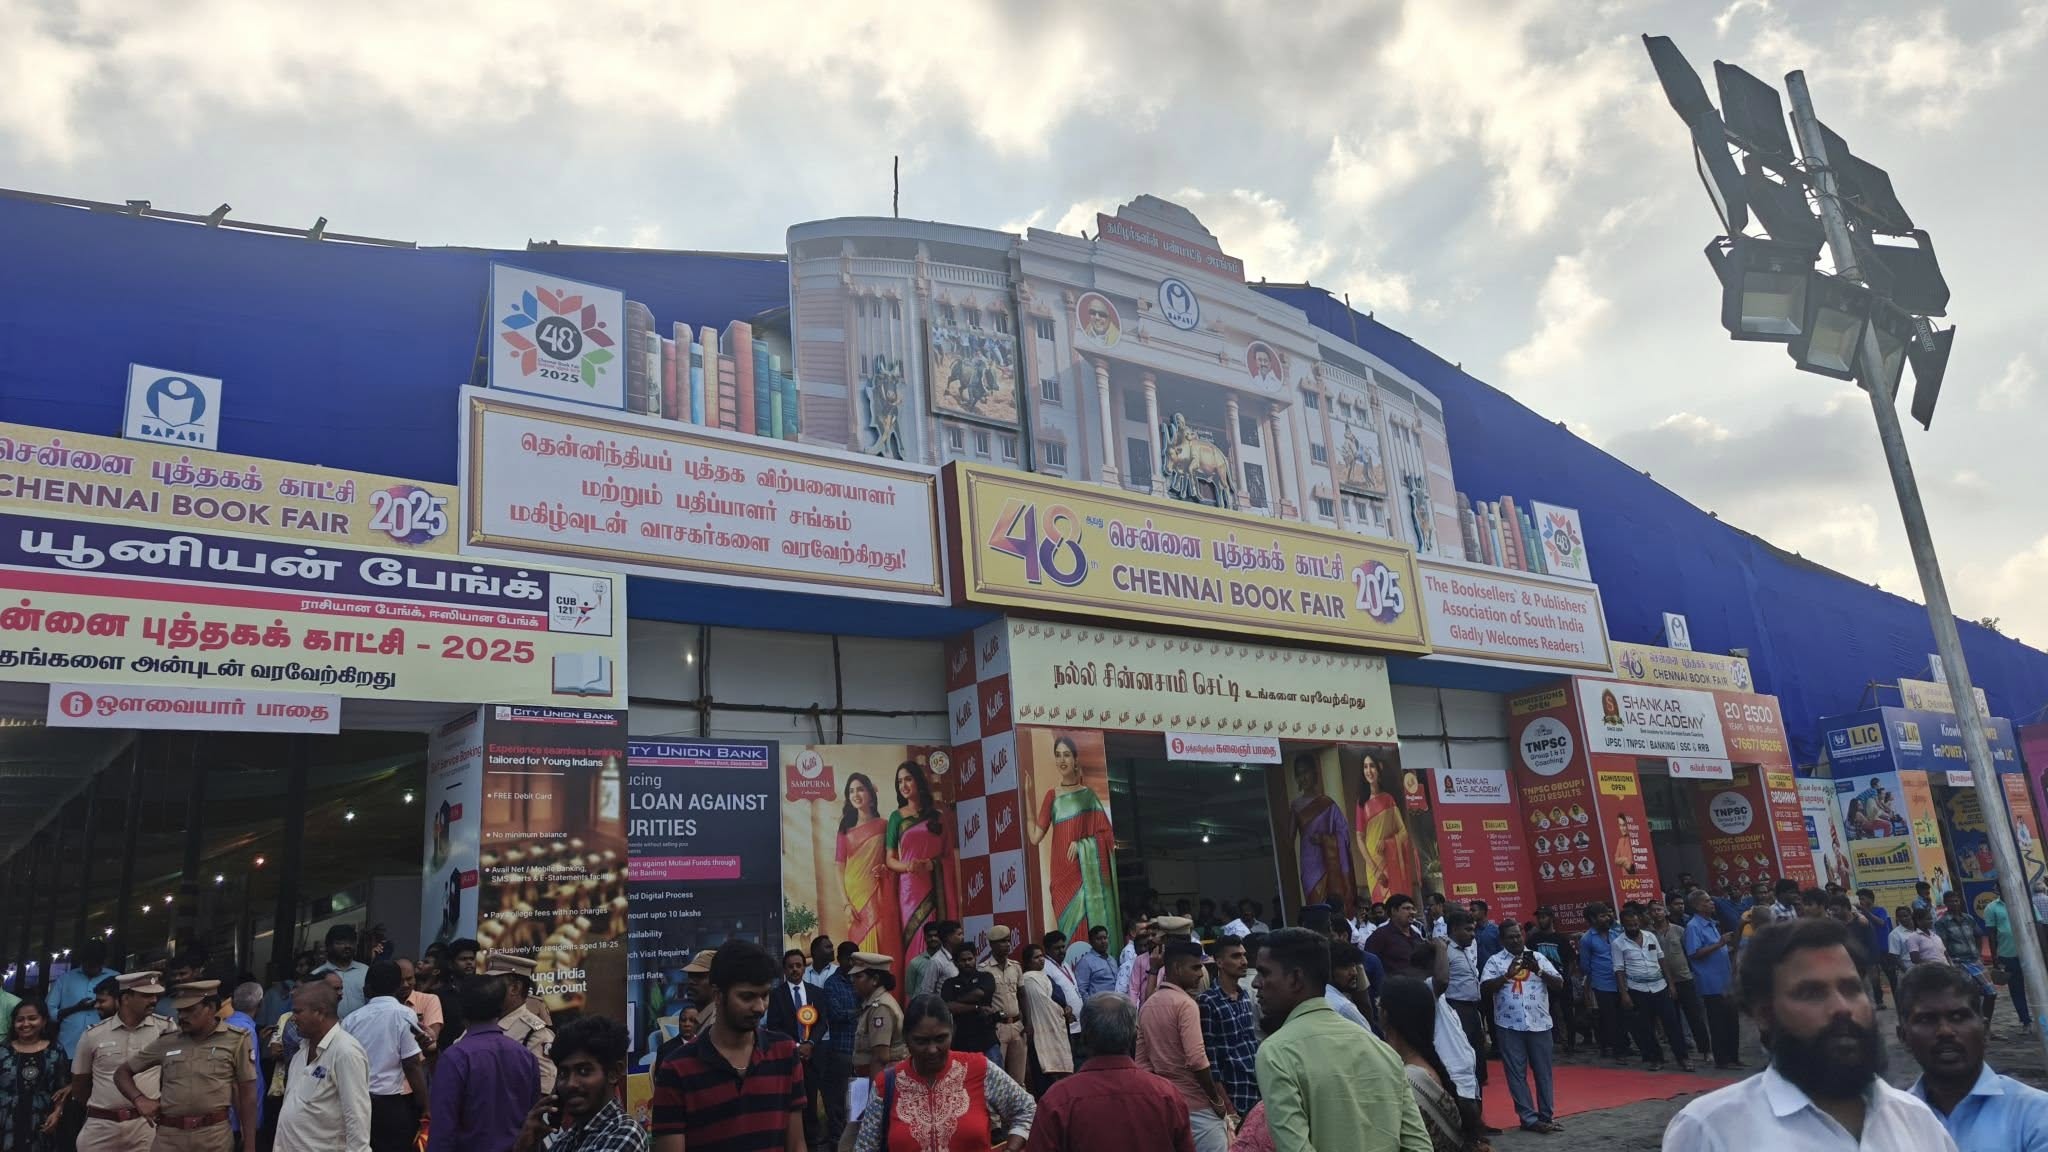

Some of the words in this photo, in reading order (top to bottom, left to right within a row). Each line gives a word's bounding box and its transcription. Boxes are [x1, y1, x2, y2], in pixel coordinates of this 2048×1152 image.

[540, 324, 575, 353] 48
[540, 368, 579, 383] 2025
[140, 424, 205, 443] BAPASI
[0, 437, 135, 475] சென்னை
[152, 455, 263, 491] புத்தகக்
[279, 475, 355, 504] காட்சி
[521, 432, 672, 472] தென்னிந்தியப்
[684, 456, 745, 484] புத்தக
[757, 468, 896, 506] விற்பனையாளர்
[0, 473, 159, 513] CHENNAI
[172, 494, 271, 526] BOOK
[281, 507, 349, 534] FAIR
[582, 476, 663, 508] மற்றும்
[676, 490, 777, 521] பதிப்பாளர்
[789, 505, 852, 531] சங்கம்
[368, 489, 448, 538] 2025
[510, 501, 628, 534] மகிழ்வுடன்
[640, 521, 770, 553] வாசகர்களை
[782, 539, 906, 572] வரவேற்கிறது!
[988, 499, 1089, 587] 48
[1109, 519, 1202, 559] சென்னை
[1213, 534, 1285, 569] புத்தகக்
[1295, 553, 1345, 581] காட்சி
[20, 530, 342, 581] யூனியன்
[359, 557, 543, 601] பேங்க்
[1112, 564, 1223, 604] CHENNAI
[1230, 582, 1295, 613] BOOK
[1300, 591, 1346, 619] FAIR
[1351, 565, 1405, 616] 2025
[1425, 576, 1448, 593] The
[1521, 591, 1532, 606] &
[556, 596, 577, 606] CUB
[558, 606, 573, 614] 121
[301, 599, 372, 614] ராசியான
[376, 603, 426, 618] பேங்க்,
[429, 610, 494, 624] ஈஸியான
[496, 616, 539, 629] பேங்க்
[1442, 600, 1507, 624] Association
[1510, 610, 1521, 624] of
[1524, 612, 1556, 630] South
[1558, 617, 1584, 633] India
[143, 613, 292, 652] புத்தகக்
[303, 628, 405, 656] காட்சி
[441, 635, 535, 664] 2025
[1450, 625, 1484, 645] Gladly
[1486, 629, 1539, 649] Welcomes
[1541, 636, 1579, 654] Readers
[982, 635, 999, 670] Nalli
[0, 647, 125, 671] தங்களை
[131, 654, 246, 680] அன்புடன்
[251, 662, 396, 690] வரவேற்கிறது
[1053, 660, 1098, 689] நல்லி
[1103, 662, 1188, 694] சின்னசாமி
[1193, 671, 1240, 702] செட்டி
[1245, 688, 1297, 701] உங்களை
[1300, 690, 1366, 709] வரவேற்கிறது
[1653, 669, 1688, 682] CHENNAI
[1690, 672, 1711, 684] BOOK
[1713, 675, 1729, 687] FAIR
[256, 700, 329, 723] பாதை
[987, 690, 1003, 725] Nalli
[1622, 695, 1681, 713] SHANKAR
[1724, 702, 1740, 719] 20
[1743, 703, 1773, 723] 2500
[513, 708, 539, 717] CITY
[543, 709, 579, 719] UNION
[583, 712, 614, 720] BANK
[1625, 712, 1646, 726] IAS
[1649, 713, 1704, 730] ACADEMY
[1525, 736, 1567, 753] TNPSC
[1605, 737, 1622, 748] UPSC
[1626, 739, 1646, 749] TNPSC
[1649, 741, 1675, 751] BANKING
[1679, 742, 1691, 752] SSC
[1697, 743, 1710, 753] RRB
[1852, 726, 1879, 746] LIC
[489, 744, 543, 756] Experience
[544, 746, 586, 756] seamless
[588, 747, 623, 758] banking
[657, 746, 711, 758] UNION
[717, 748, 762, 759] BANK
[1252, 745, 1277, 757] பாதை
[1530, 752, 1549, 761] Group
[1932, 744, 1963, 759] EmPOWER
[489, 755, 525, 765] tailored
[527, 756, 540, 765] for
[541, 757, 570, 768] Young
[572, 758, 604, 767] Indians
[801, 756, 817, 774] Nalli
[1534, 757, 1564, 767] Coaching
[791, 780, 830, 788] SAMPURNA
[1523, 785, 1549, 796] TNPSC
[1551, 780, 1581, 792] GROUP
[1600, 775, 1633, 783] ADMISSIONS
[1611, 783, 1626, 791] OPEN
[493, 792, 512, 800] FREE
[514, 792, 534, 800] Debit
[630, 793, 683, 810] LOAN
[688, 793, 768, 811] AGAINST
[1713, 806, 1748, 817] TNPSC
[1631, 838, 1639, 846] IAS
[1632, 846, 1648, 854] Dream
[642, 860, 667, 869] against
[711, 859, 737, 868] through
[1634, 854, 1647, 862] Come
[1857, 856, 1887, 868] JEEVAN
[1888, 848, 1910, 865] LABH
[640, 869, 667, 878] Banking
[1620, 878, 1641, 890] UPSC
[640, 891, 664, 901] Digital
[665, 891, 694, 899] Process
[489, 945, 531, 955] Exclusively
[532, 945, 543, 953] for
[544, 943, 578, 952] residents
[579, 942, 597, 952] aged
[598, 941, 619, 949] 18-25
[639, 950, 657, 958] Visit
[658, 947, 690, 958] Required
[557, 967, 586, 979] India
[535, 980, 587, 996] Account
